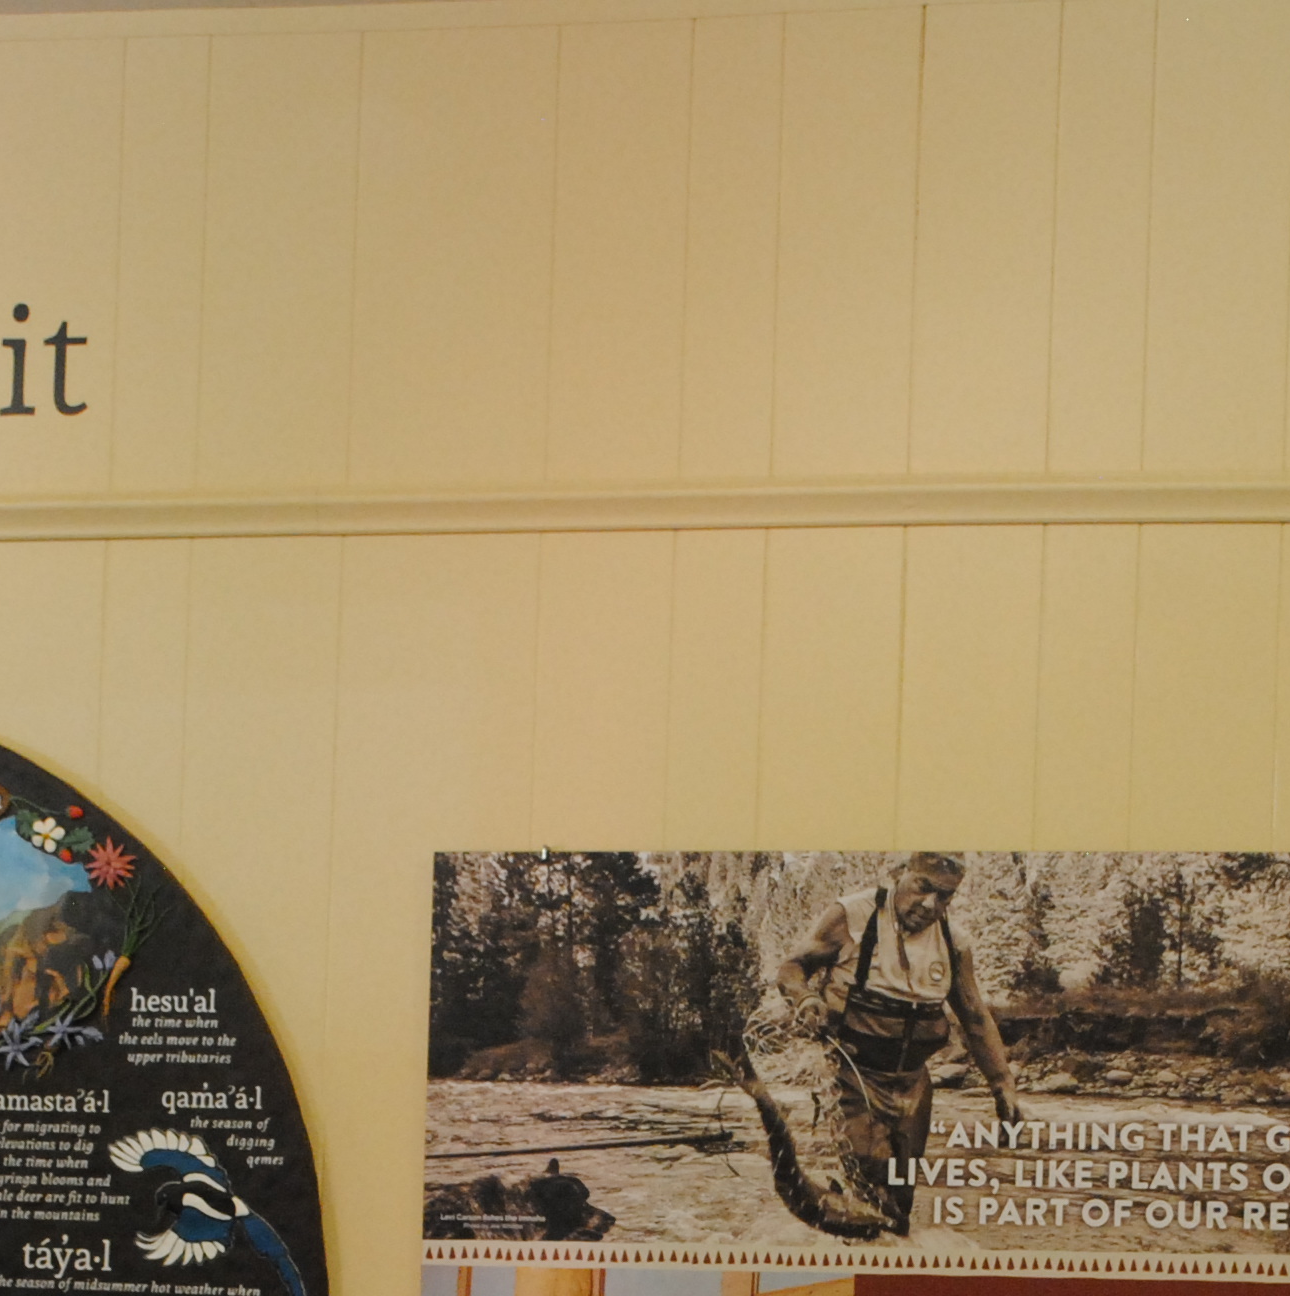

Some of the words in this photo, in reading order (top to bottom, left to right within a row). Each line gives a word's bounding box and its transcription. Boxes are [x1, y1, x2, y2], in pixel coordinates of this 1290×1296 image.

[1158, 1123, 1250, 1153] THAT
[887, 1158, 1001, 1192] LIVES,
[1015, 1159, 1095, 1189] LIKE
[1107, 1161, 1249, 1192] PLANTS
[932, 1196, 965, 1226] IS
[979, 1197, 1069, 1227] PART
[1081, 1198, 1131, 1228] OF
[1144, 1200, 1228, 1230] OUR
